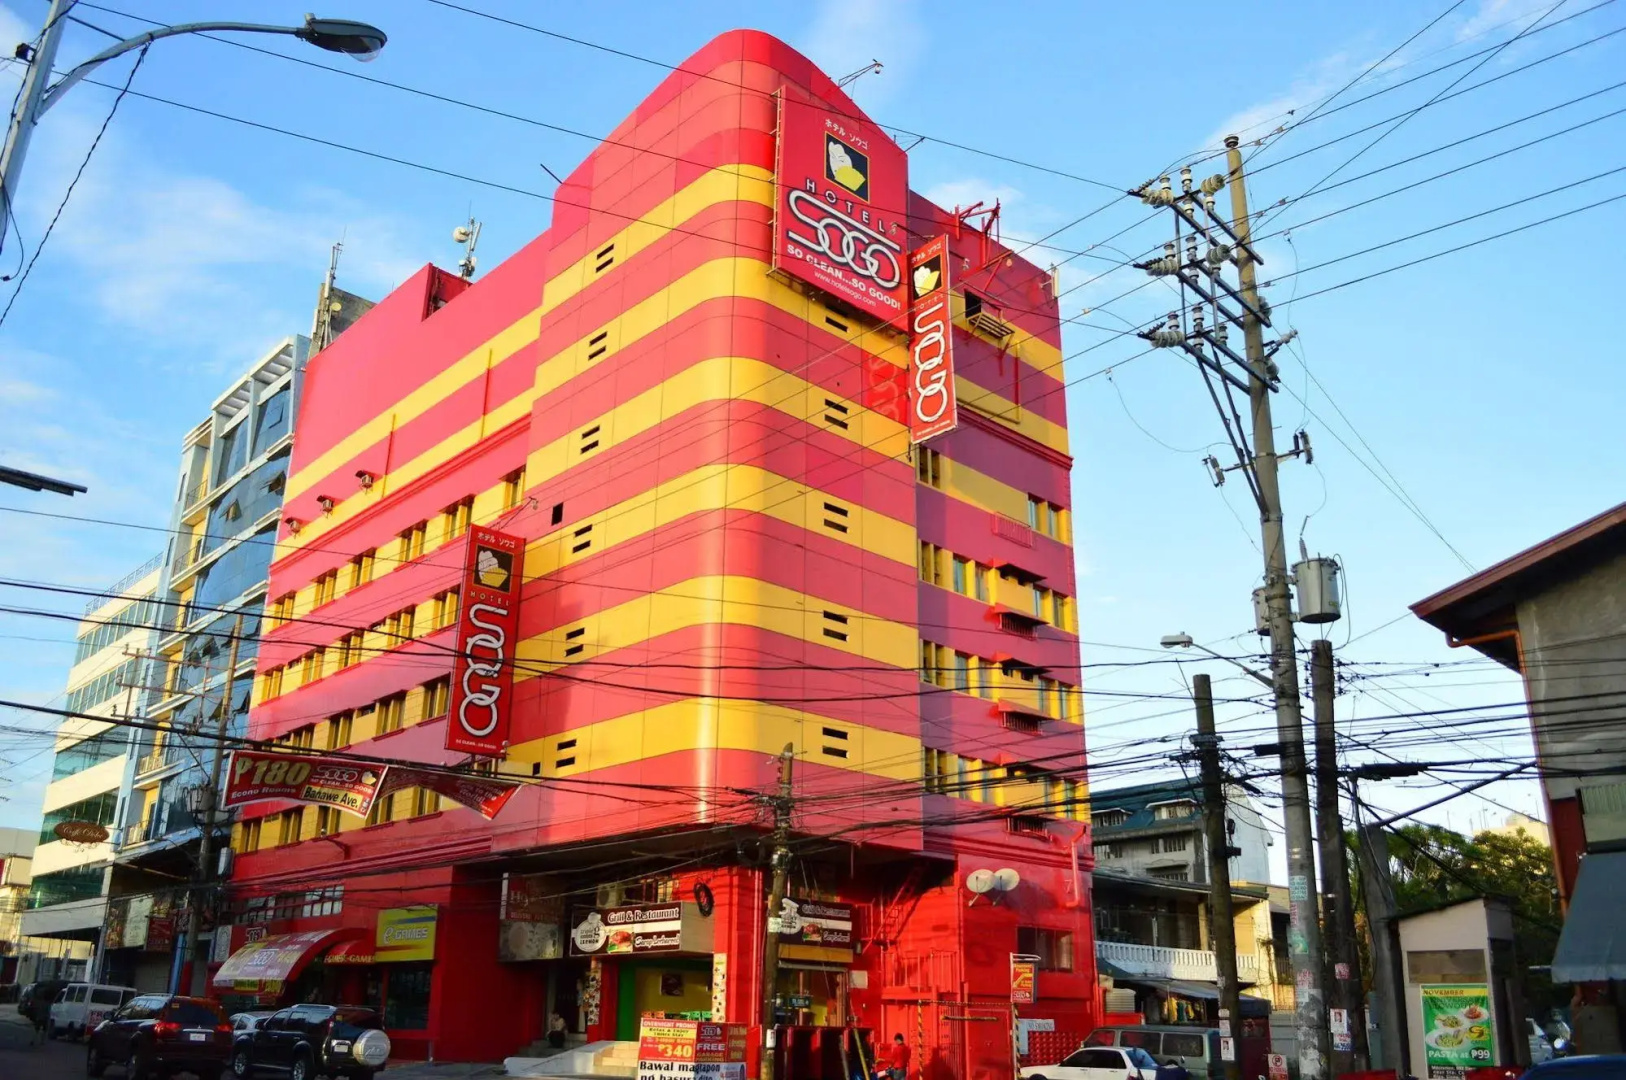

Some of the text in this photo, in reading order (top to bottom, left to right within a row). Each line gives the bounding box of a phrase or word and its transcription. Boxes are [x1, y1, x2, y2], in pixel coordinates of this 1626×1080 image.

[805, 178, 886, 233] HOTEL
[787, 189, 901, 288] SOGO
[787, 244, 803, 259] SO
[868, 287, 901, 311] GOOD!
[914, 302, 948, 422] SOGO
[470, 591, 509, 606] HOTEL
[459, 603, 508, 736] SOGO
[231, 788, 259, 798] Econo
[304, 786, 339, 802] Banawe
[340, 792, 358, 808] Ave.
[608, 907, 680, 924] Grill & Restaurant
[697, 1043, 725, 1051] FREE
[1428, 1050, 1458, 1058] PASTA
[640, 1061, 674, 1071] Bawal
